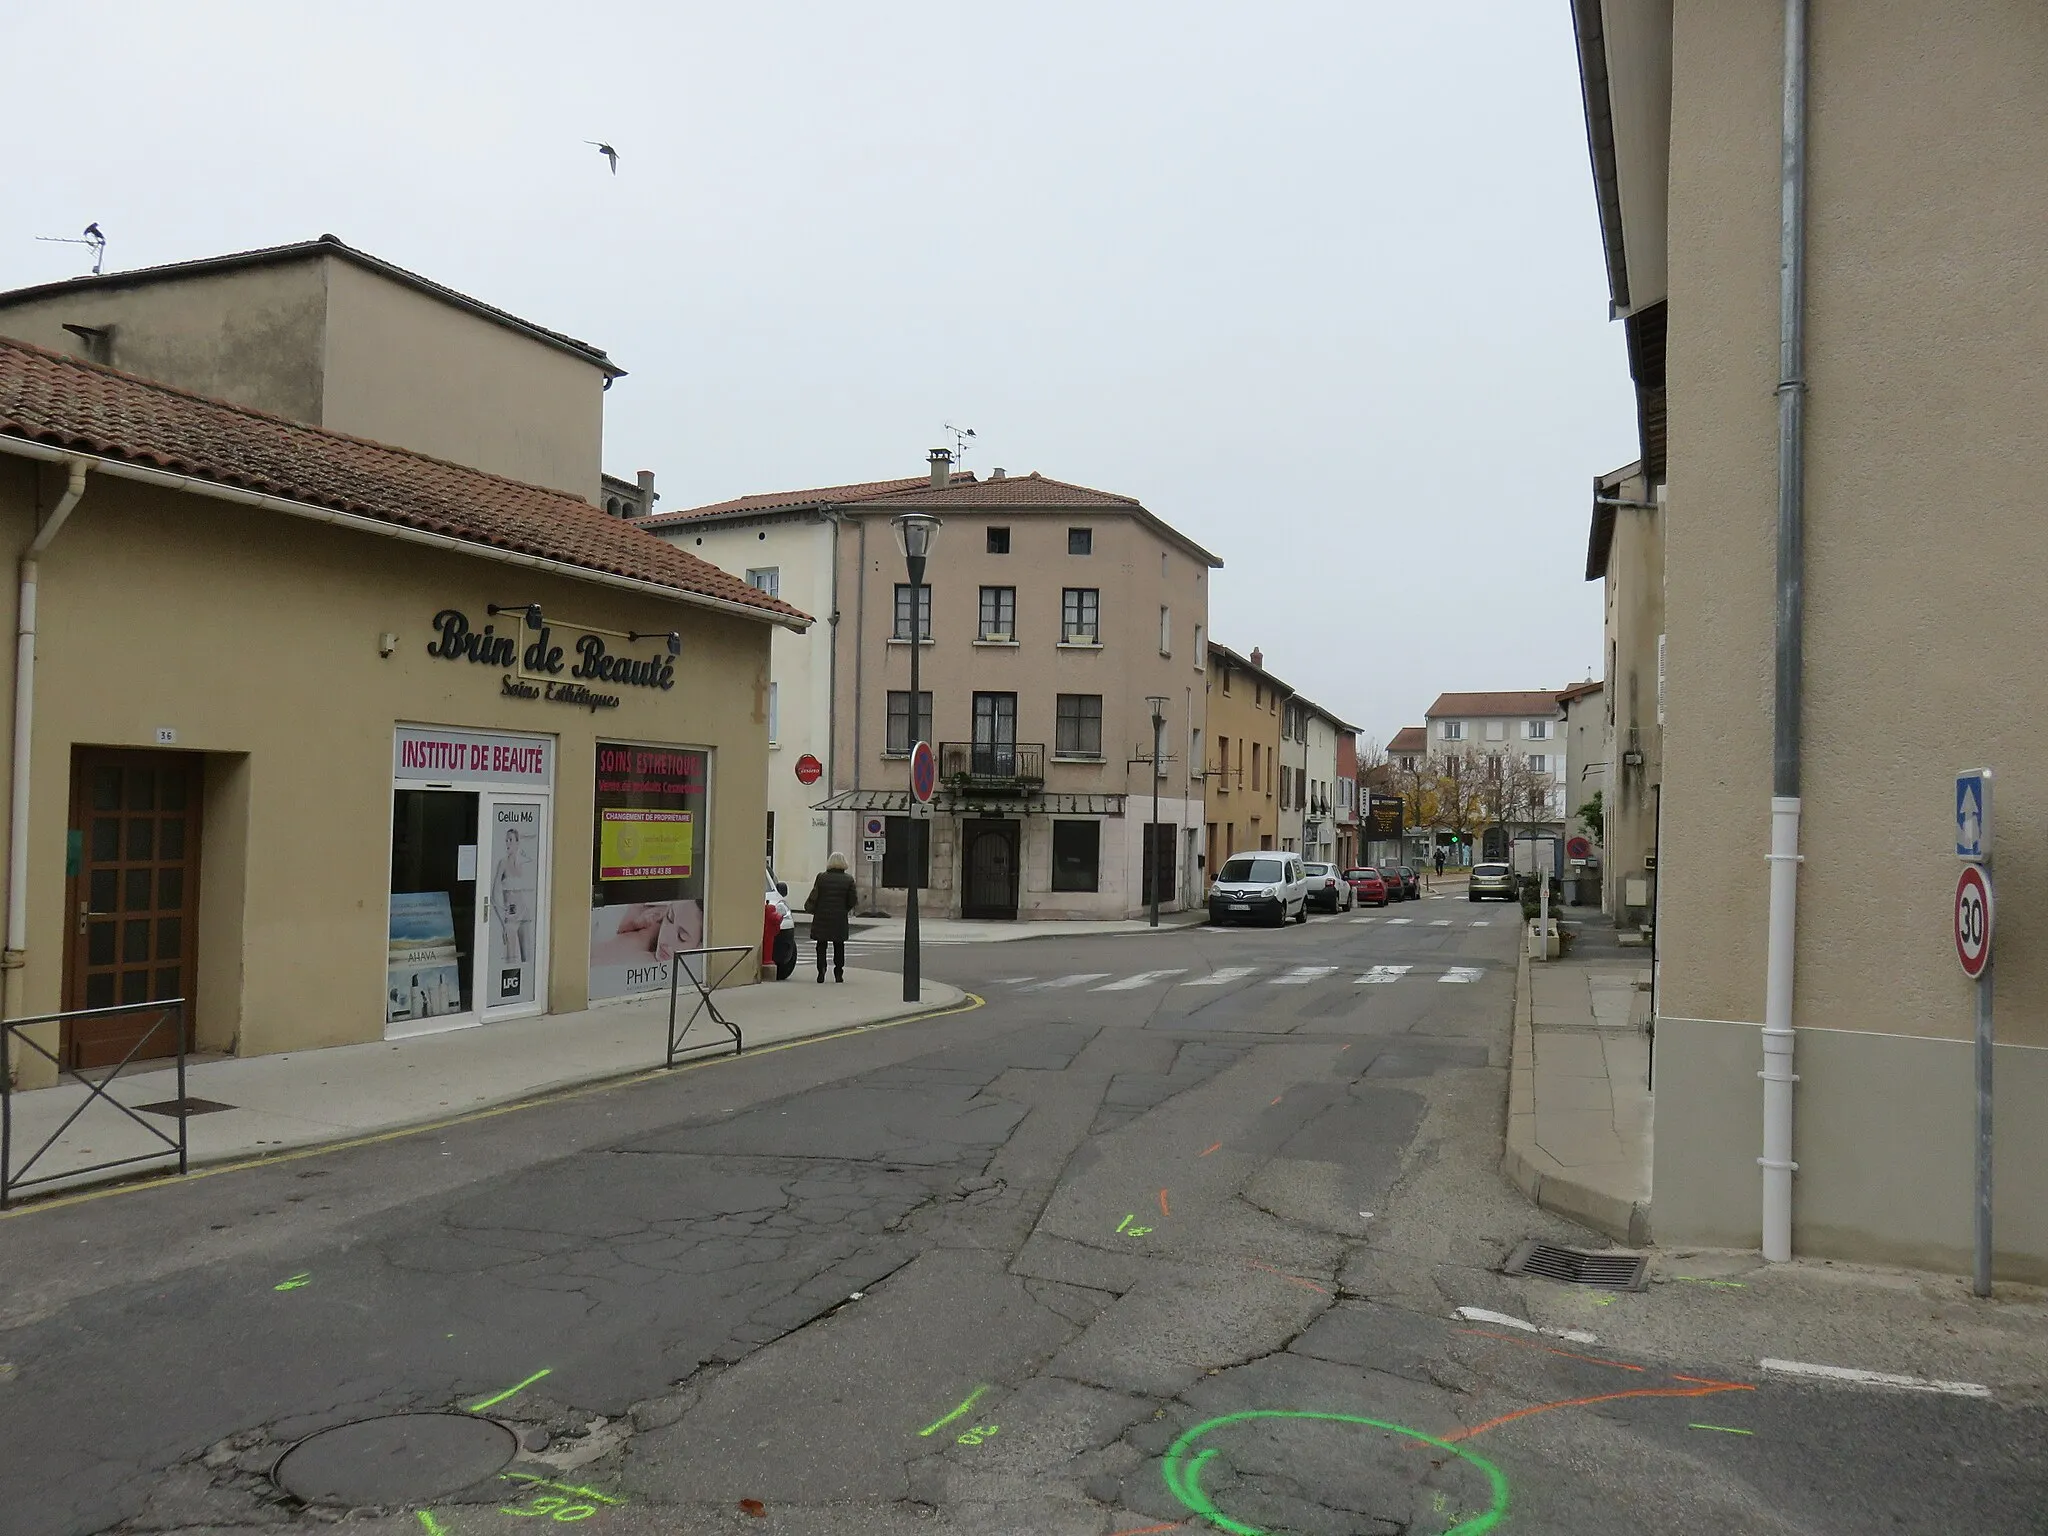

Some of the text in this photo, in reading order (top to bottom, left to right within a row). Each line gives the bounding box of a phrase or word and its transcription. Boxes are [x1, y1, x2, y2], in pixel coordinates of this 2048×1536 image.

[427, 609, 677, 691] Brin de Beauté
[501, 674, 540, 699] Soins
[161, 731, 173, 740] 36
[402, 740, 543, 774] INSTITUT DE BEAUTÉ
[600, 750, 632, 773] SOINS
[497, 811, 533, 823] Cellu M6
[606, 812, 645, 822] CHANGEMENT
[645, 813, 654, 822] DE
[1960, 897, 1983, 946] 30
[503, 976, 519, 989] LPG
[626, 963, 668, 985] PHYT'S
